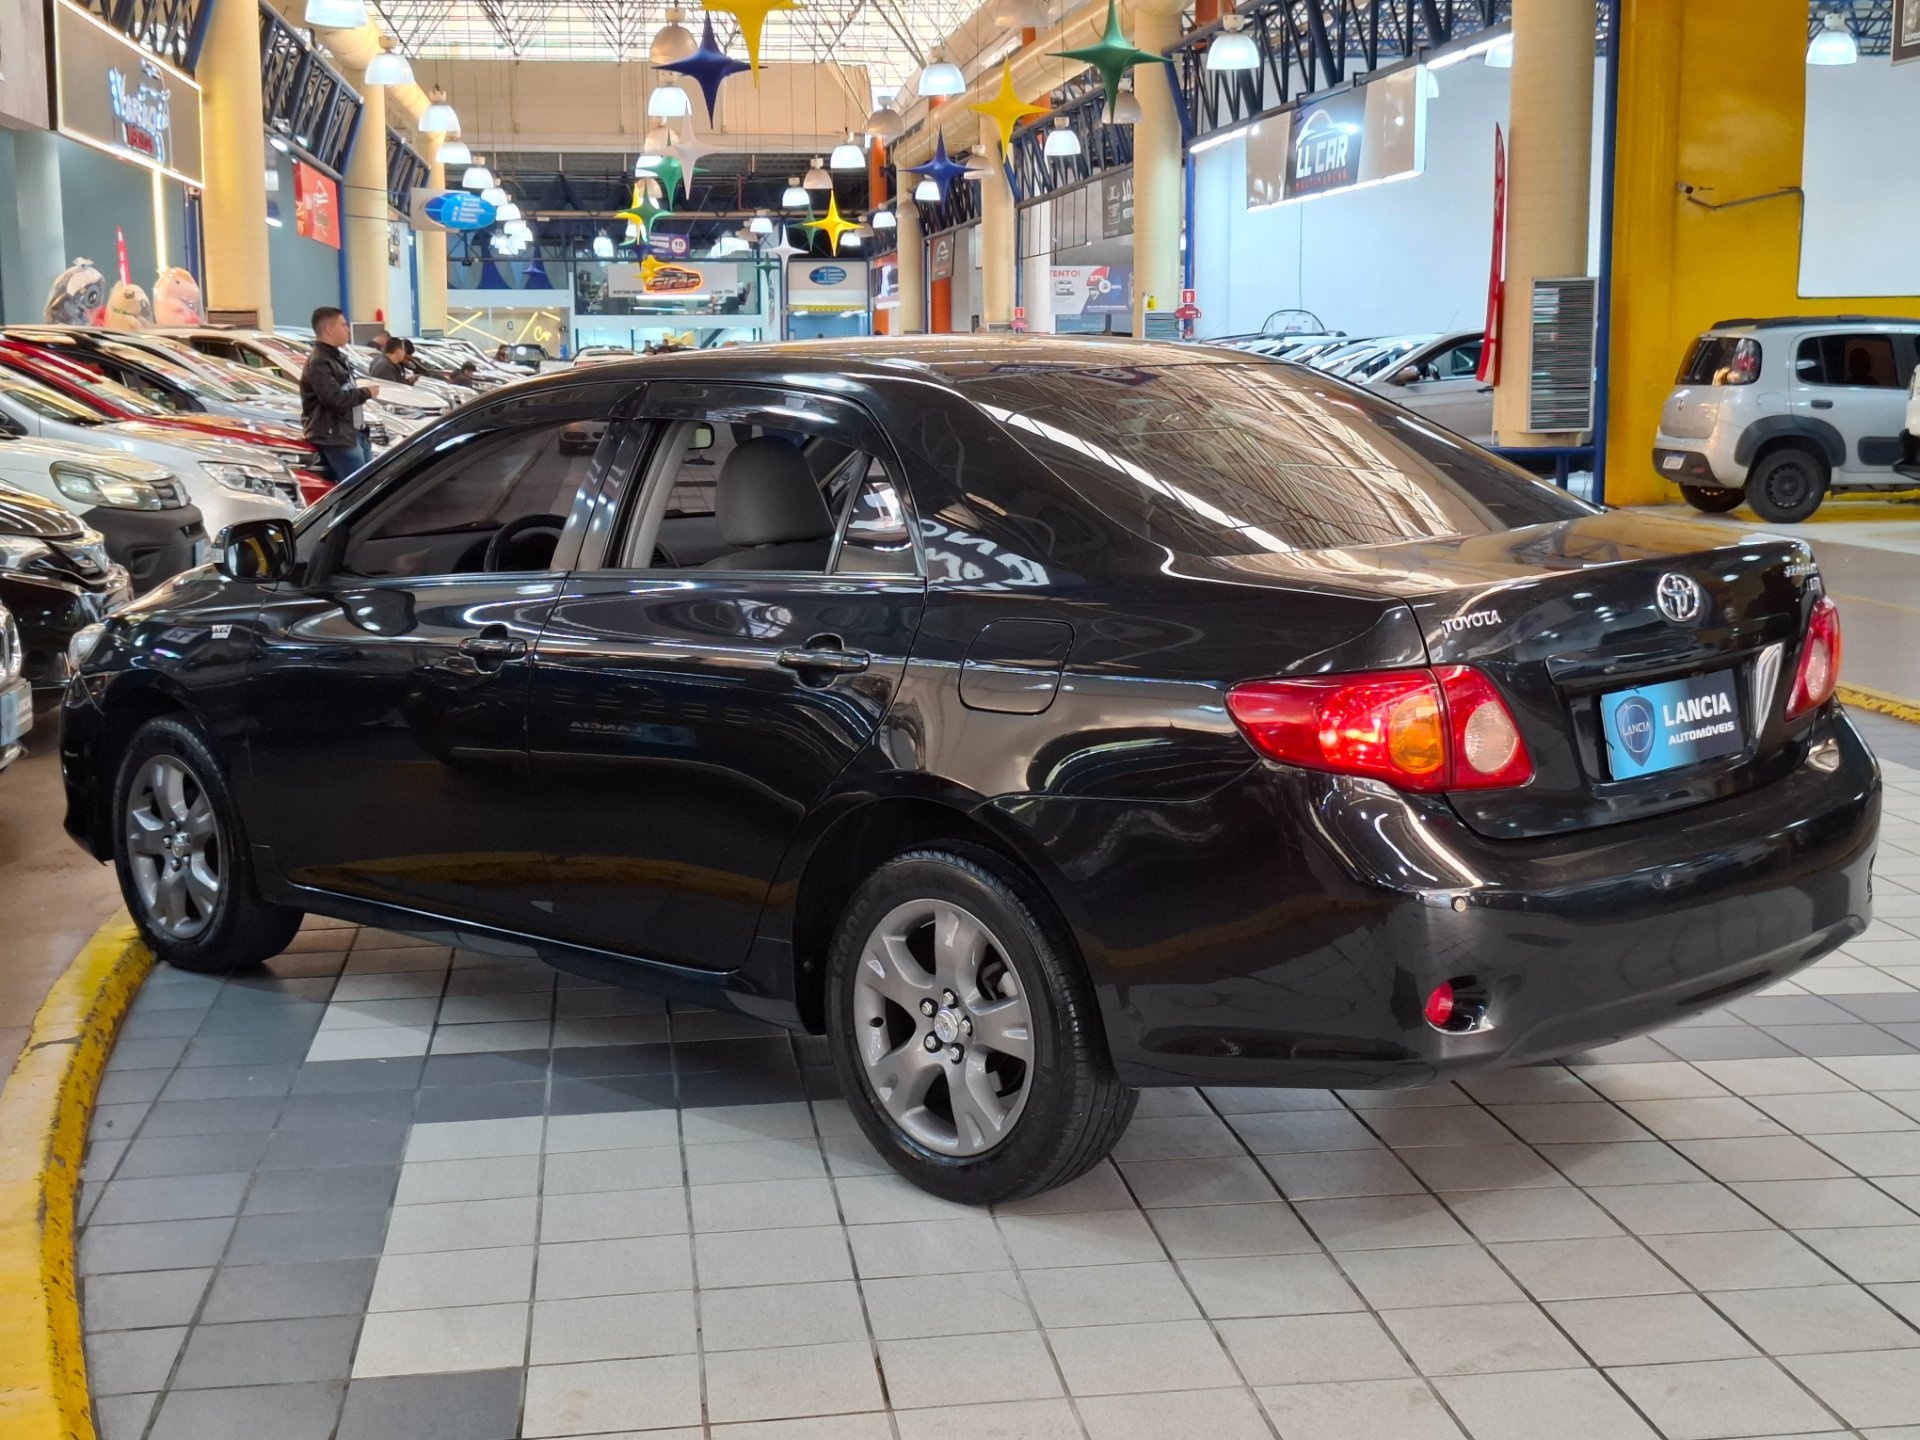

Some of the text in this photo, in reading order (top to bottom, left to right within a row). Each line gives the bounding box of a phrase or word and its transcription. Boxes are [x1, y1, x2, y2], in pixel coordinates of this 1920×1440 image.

[1315, 134, 1349, 174] CAR
[1441, 610, 1502, 633] TOYOTA
[1663, 692, 1731, 727] LANCIA
[1623, 721, 1650, 736] LANCIA
[1668, 721, 1735, 746] AUTOMÓVEIS
